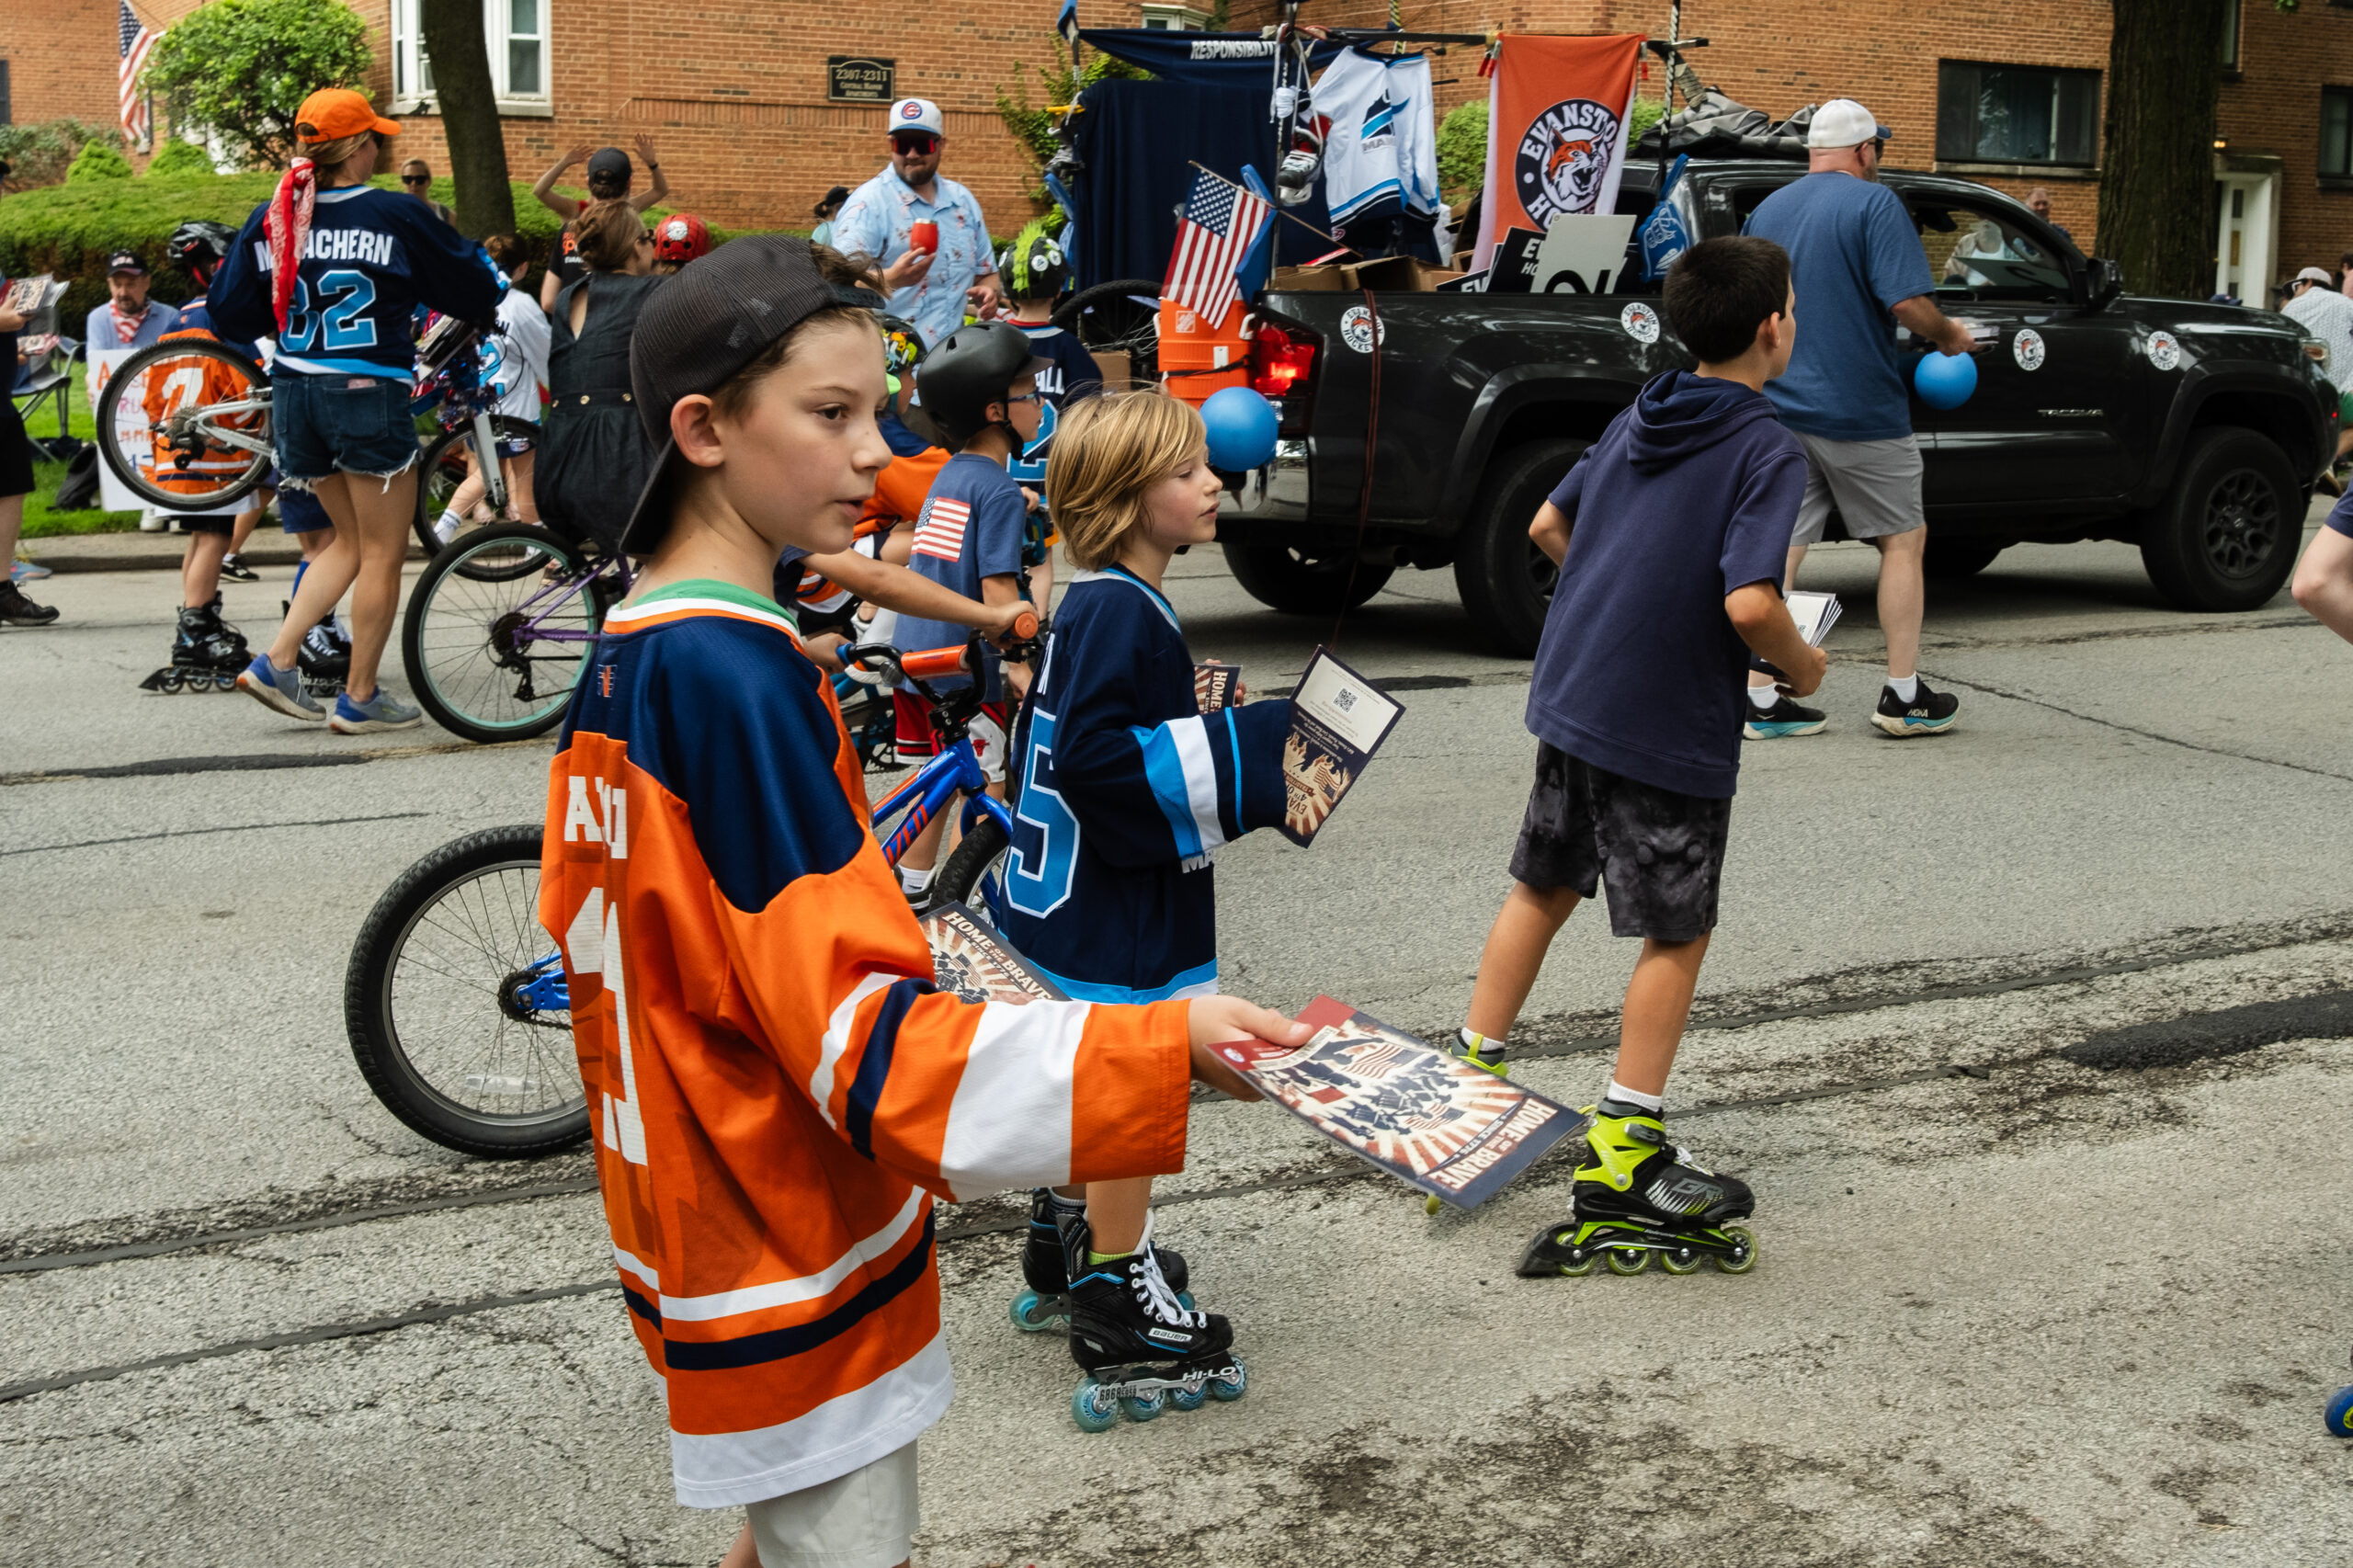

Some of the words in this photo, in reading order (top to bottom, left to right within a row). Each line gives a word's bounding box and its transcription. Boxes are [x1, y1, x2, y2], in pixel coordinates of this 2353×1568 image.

[835, 69, 888, 82] 2307-2311
[1211, 671, 1229, 709] HOME
[1006, 706, 1080, 919] 5
[941, 911, 996, 950] HOME
[1498, 1097, 1559, 1142] HOME
[1427, 1146, 1502, 1190] BRAVE
[1182, 1366, 1236, 1383] HI-LO
